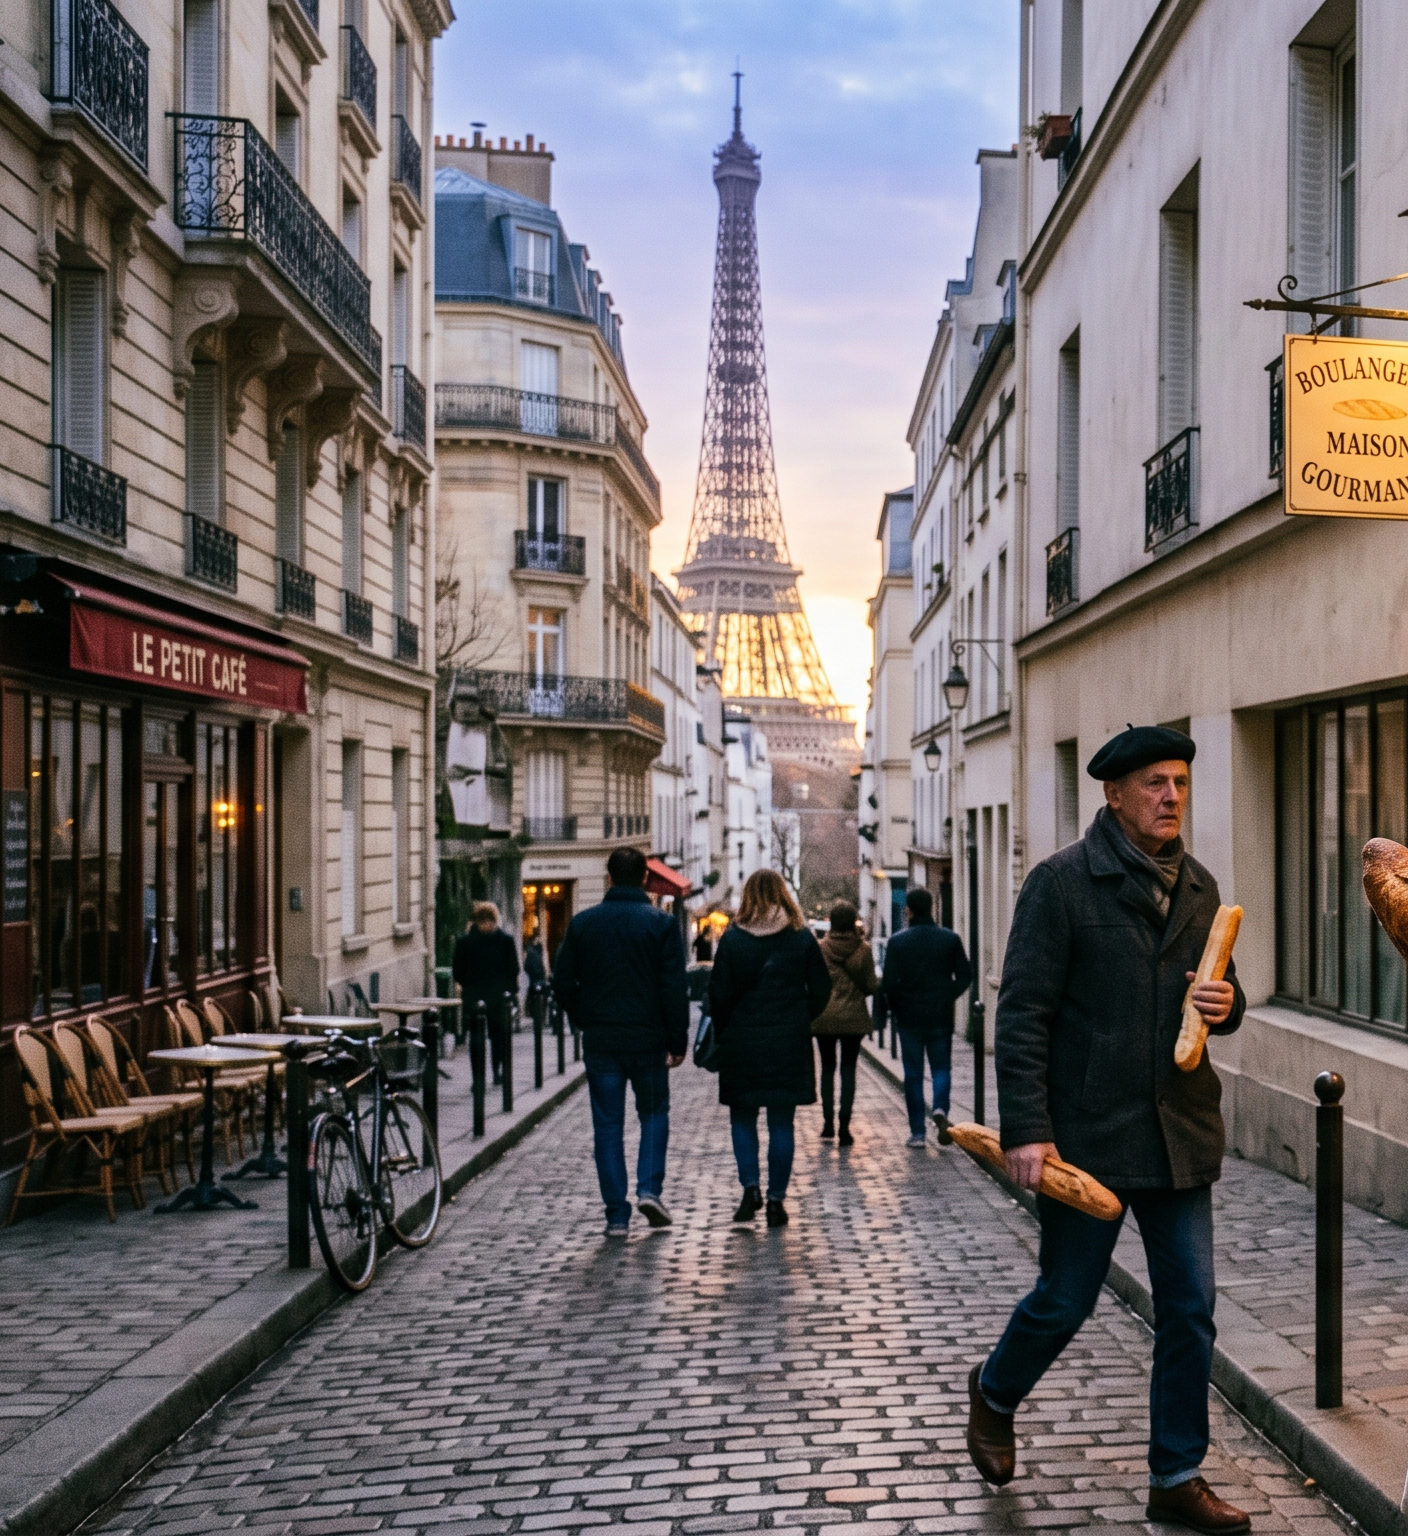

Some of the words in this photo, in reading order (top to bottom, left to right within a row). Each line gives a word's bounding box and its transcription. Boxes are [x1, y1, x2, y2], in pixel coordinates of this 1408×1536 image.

[132, 631, 154, 675] LE
[160, 638, 206, 686] PETIT
[211, 653, 247, 696] CAFÉ
